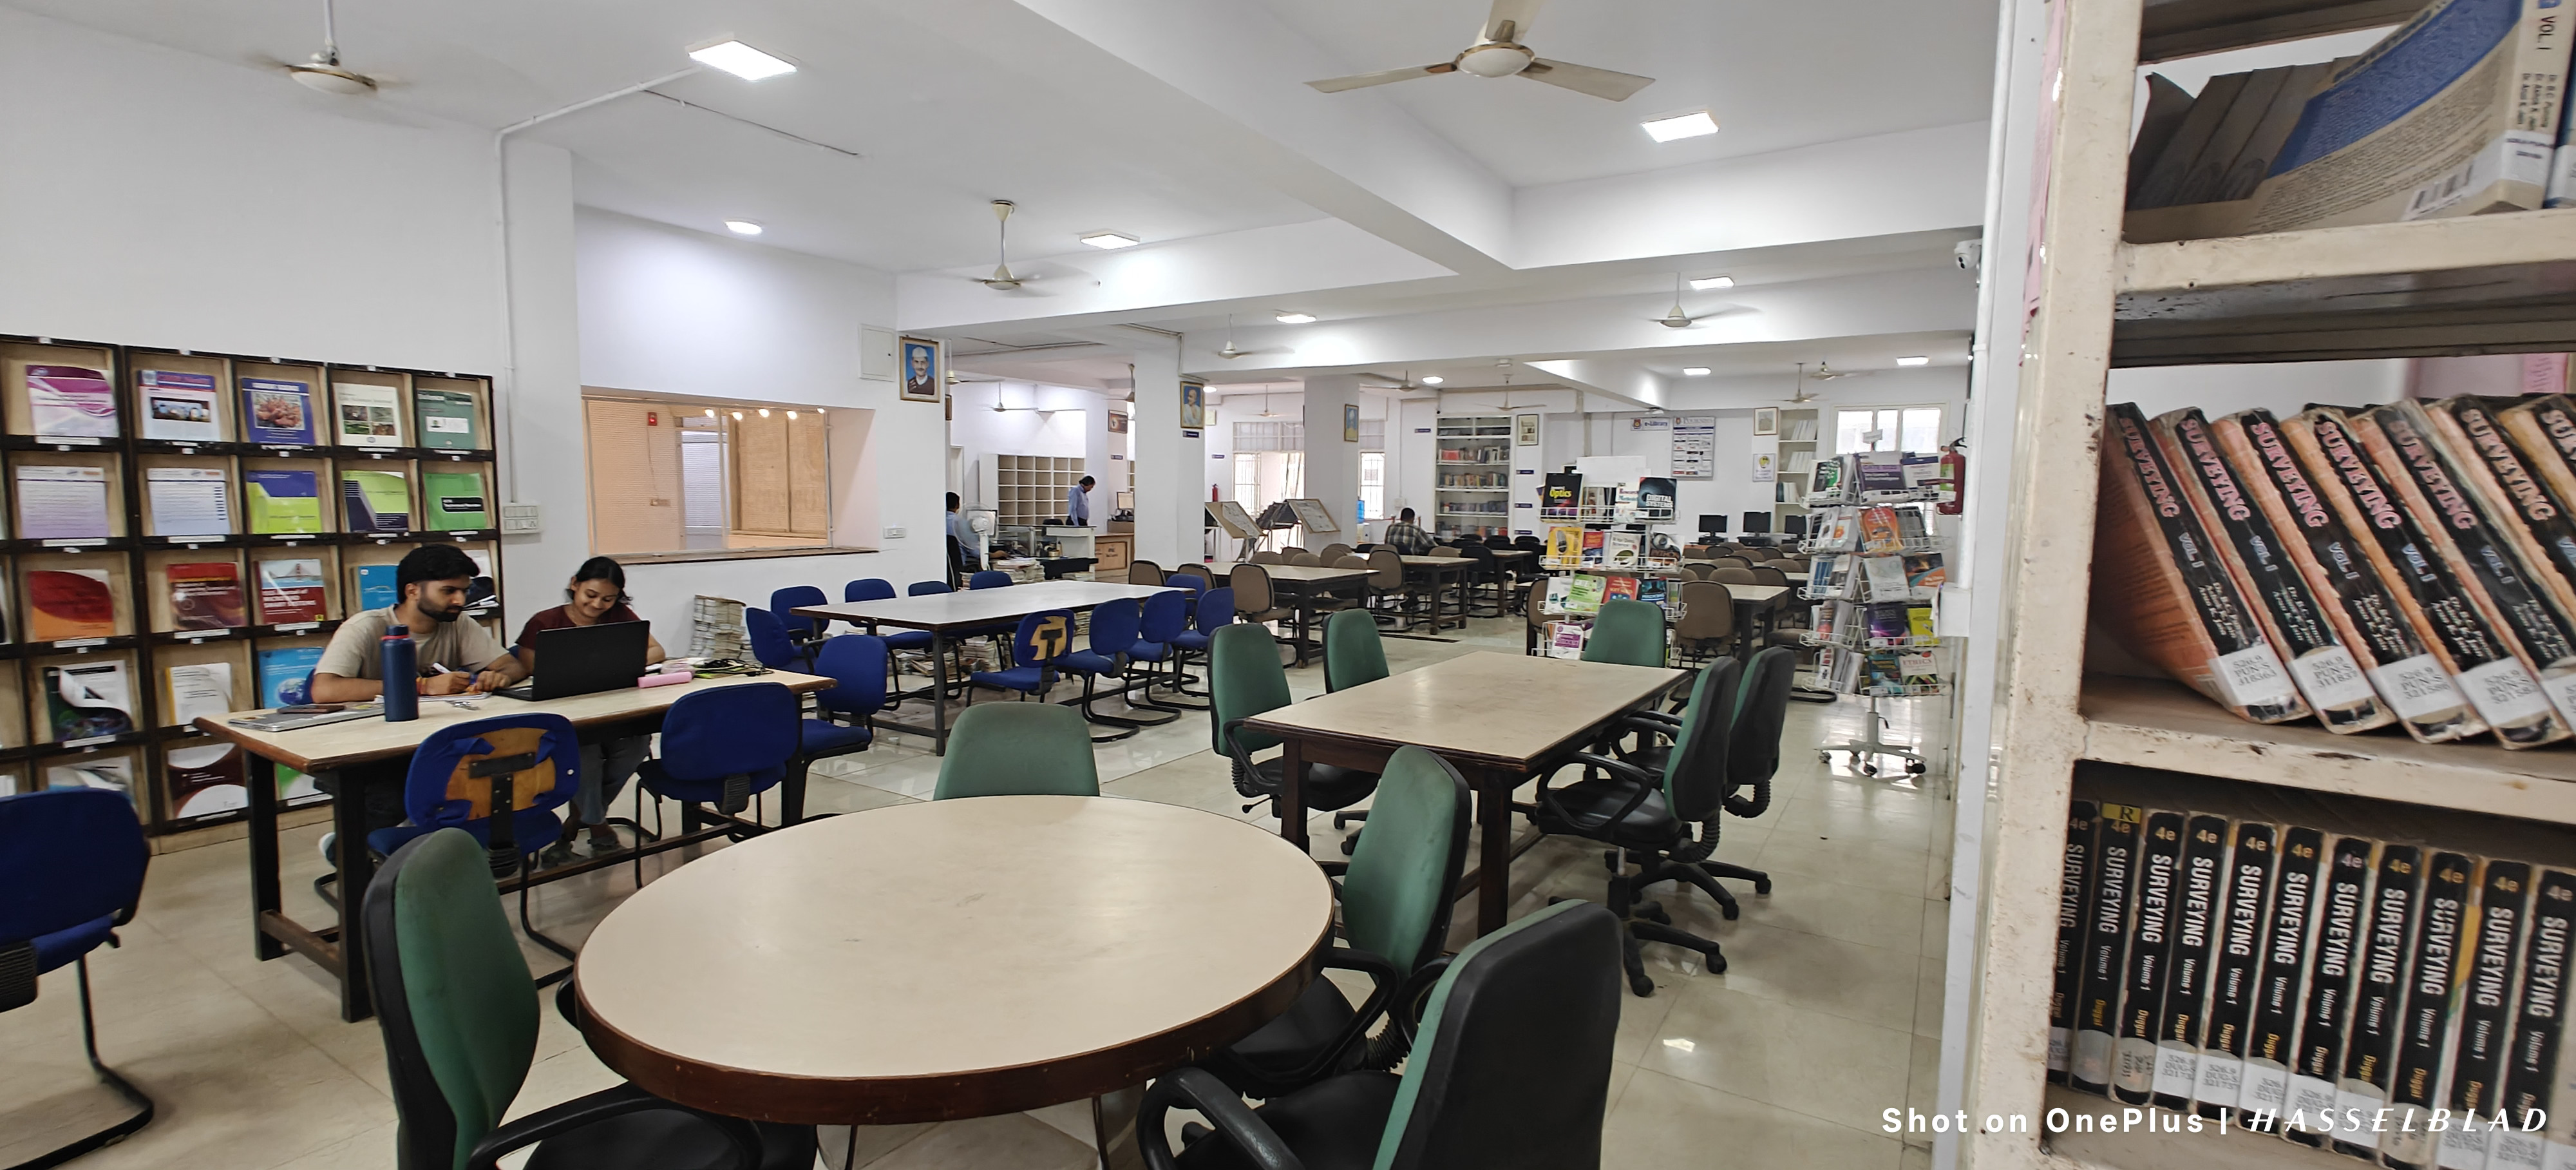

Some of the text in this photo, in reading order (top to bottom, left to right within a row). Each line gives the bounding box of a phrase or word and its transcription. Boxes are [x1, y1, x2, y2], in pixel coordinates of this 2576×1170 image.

[2537, 15, 2557, 44] VOL.
[2179, 419, 2251, 521] SURVEYING
[2250, 422, 2329, 528] SURVEYING
[2316, 421, 2402, 529] SURVEYING
[2388, 419, 2478, 530] SURVEYING
[2460, 408, 2557, 521] SURVEYING
[1549, 488, 1572, 499] Optics
[1646, 494, 1672, 503] DIGITAL
[2111, 820, 2131, 834] 4e
[2121, 807, 2134, 821] R
[2155, 826, 2176, 841] 4e
[2196, 829, 2217, 844] 4e
[2245, 836, 2268, 851] 4e
[2291, 843, 2315, 859] 4e
[2342, 852, 2363, 868] 4e
[2388, 858, 2412, 874] 4e
[2060, 843, 2085, 928] SURVEYING
[2098, 846, 2128, 934] SURVEYING
[2439, 867, 2465, 884] 4e
[2494, 876, 2520, 893] 4e
[2141, 854, 2173, 944] SURVEYING
[2182, 856, 2214, 947] SURVEYING
[2546, 885, 2574, 901] 4e
[2229, 864, 2262, 957] SURVEYING
[2274, 872, 2309, 965] SURVEYING
[2322, 881, 2359, 977] SURVEYING
[2370, 887, 2408, 984] SURVEYING
[2058, 939, 2070, 966] Volume
[2098, 945, 2112, 975] Volume
[2420, 897, 2459, 996] SURVEYING
[2475, 906, 2515, 1007] SURVEYING
[2141, 955, 2155, 986] Volume
[2181, 959, 2197, 990] Volume
[2528, 916, 2568, 1018] SURVEYING
[2226, 968, 2243, 1000] Volume
[2271, 976, 2287, 1008] Volume
[2092, 999, 2107, 1027] Duggal
[2319, 988, 2337, 1021] Volume
[2367, 996, 2385, 1030] Volume
[2134, 1009, 2149, 1038] Duggal
[2174, 1013, 2190, 1042] Duggal
[2418, 1008, 2438, 1042] Volume
[2473, 1019, 2492, 1053] Volume
[2526, 1030, 2545, 1065] Volume
